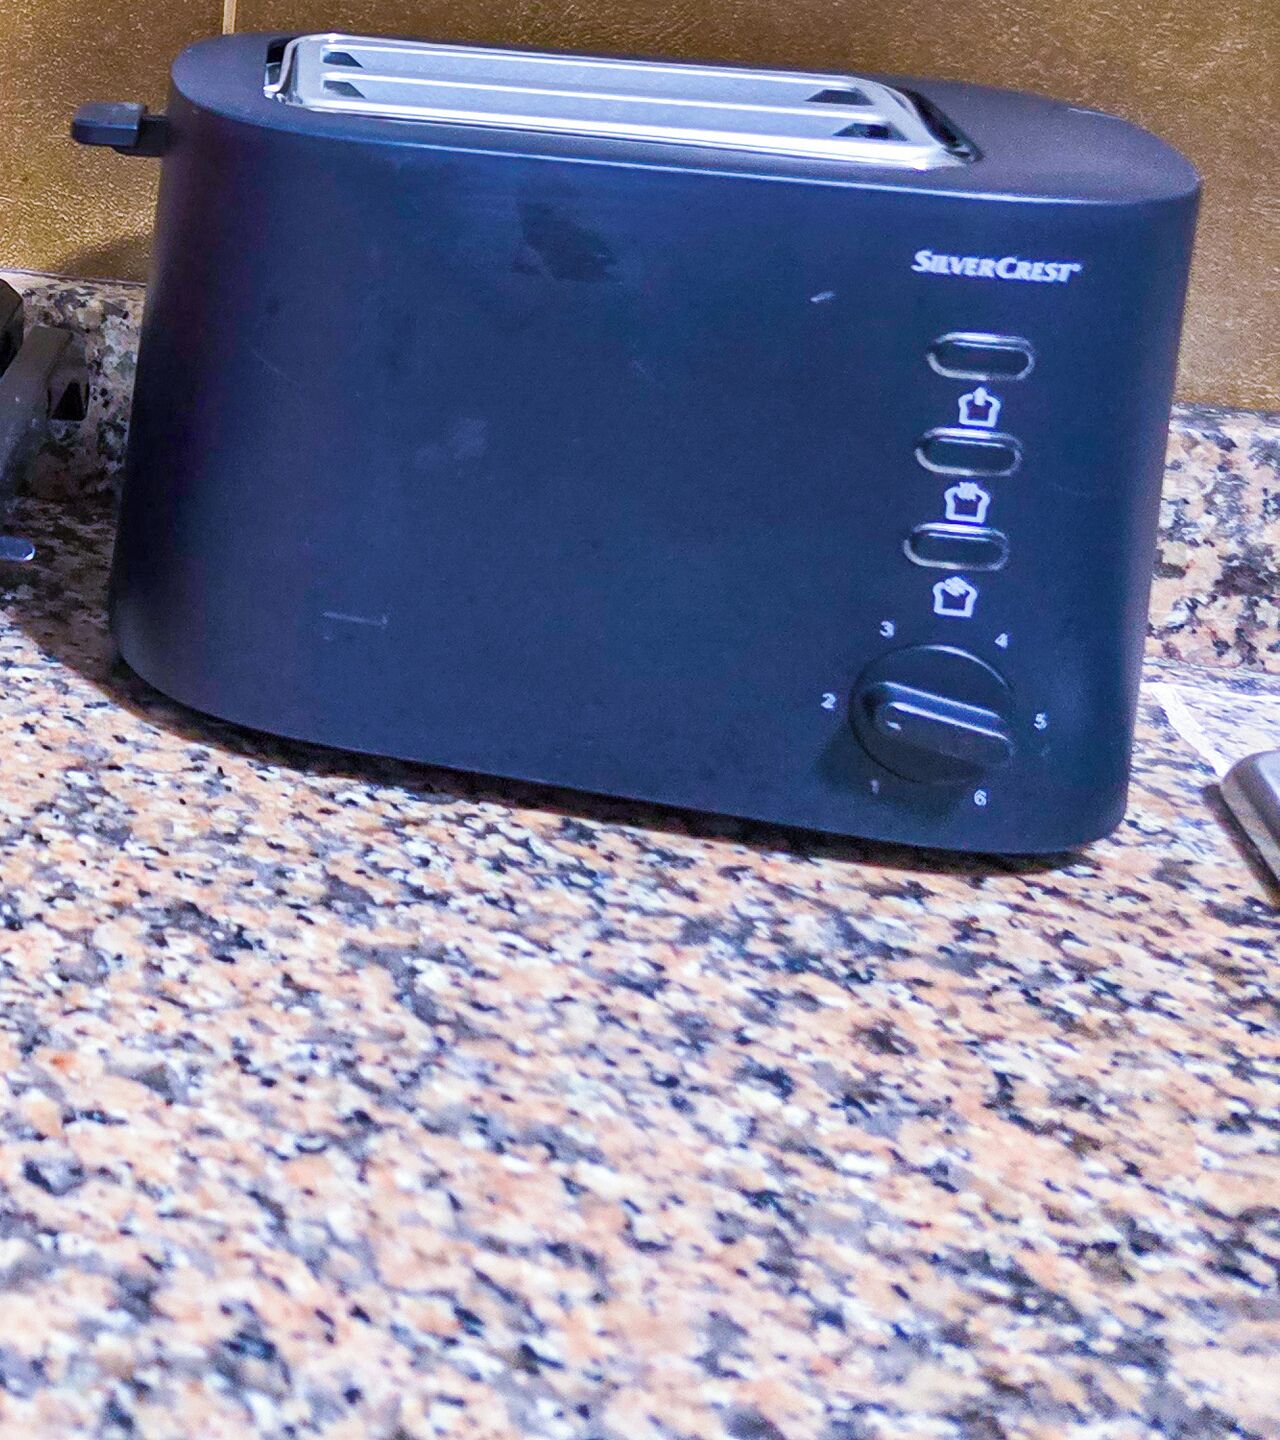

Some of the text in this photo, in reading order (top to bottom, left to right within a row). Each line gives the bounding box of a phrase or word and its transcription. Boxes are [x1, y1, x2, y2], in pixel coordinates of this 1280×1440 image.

[879, 620, 895, 639] 3
[994, 633, 1008, 649] 4
[820, 692, 836, 709] 2
[1033, 713, 1047, 730] 5
[973, 789, 988, 806] 6
